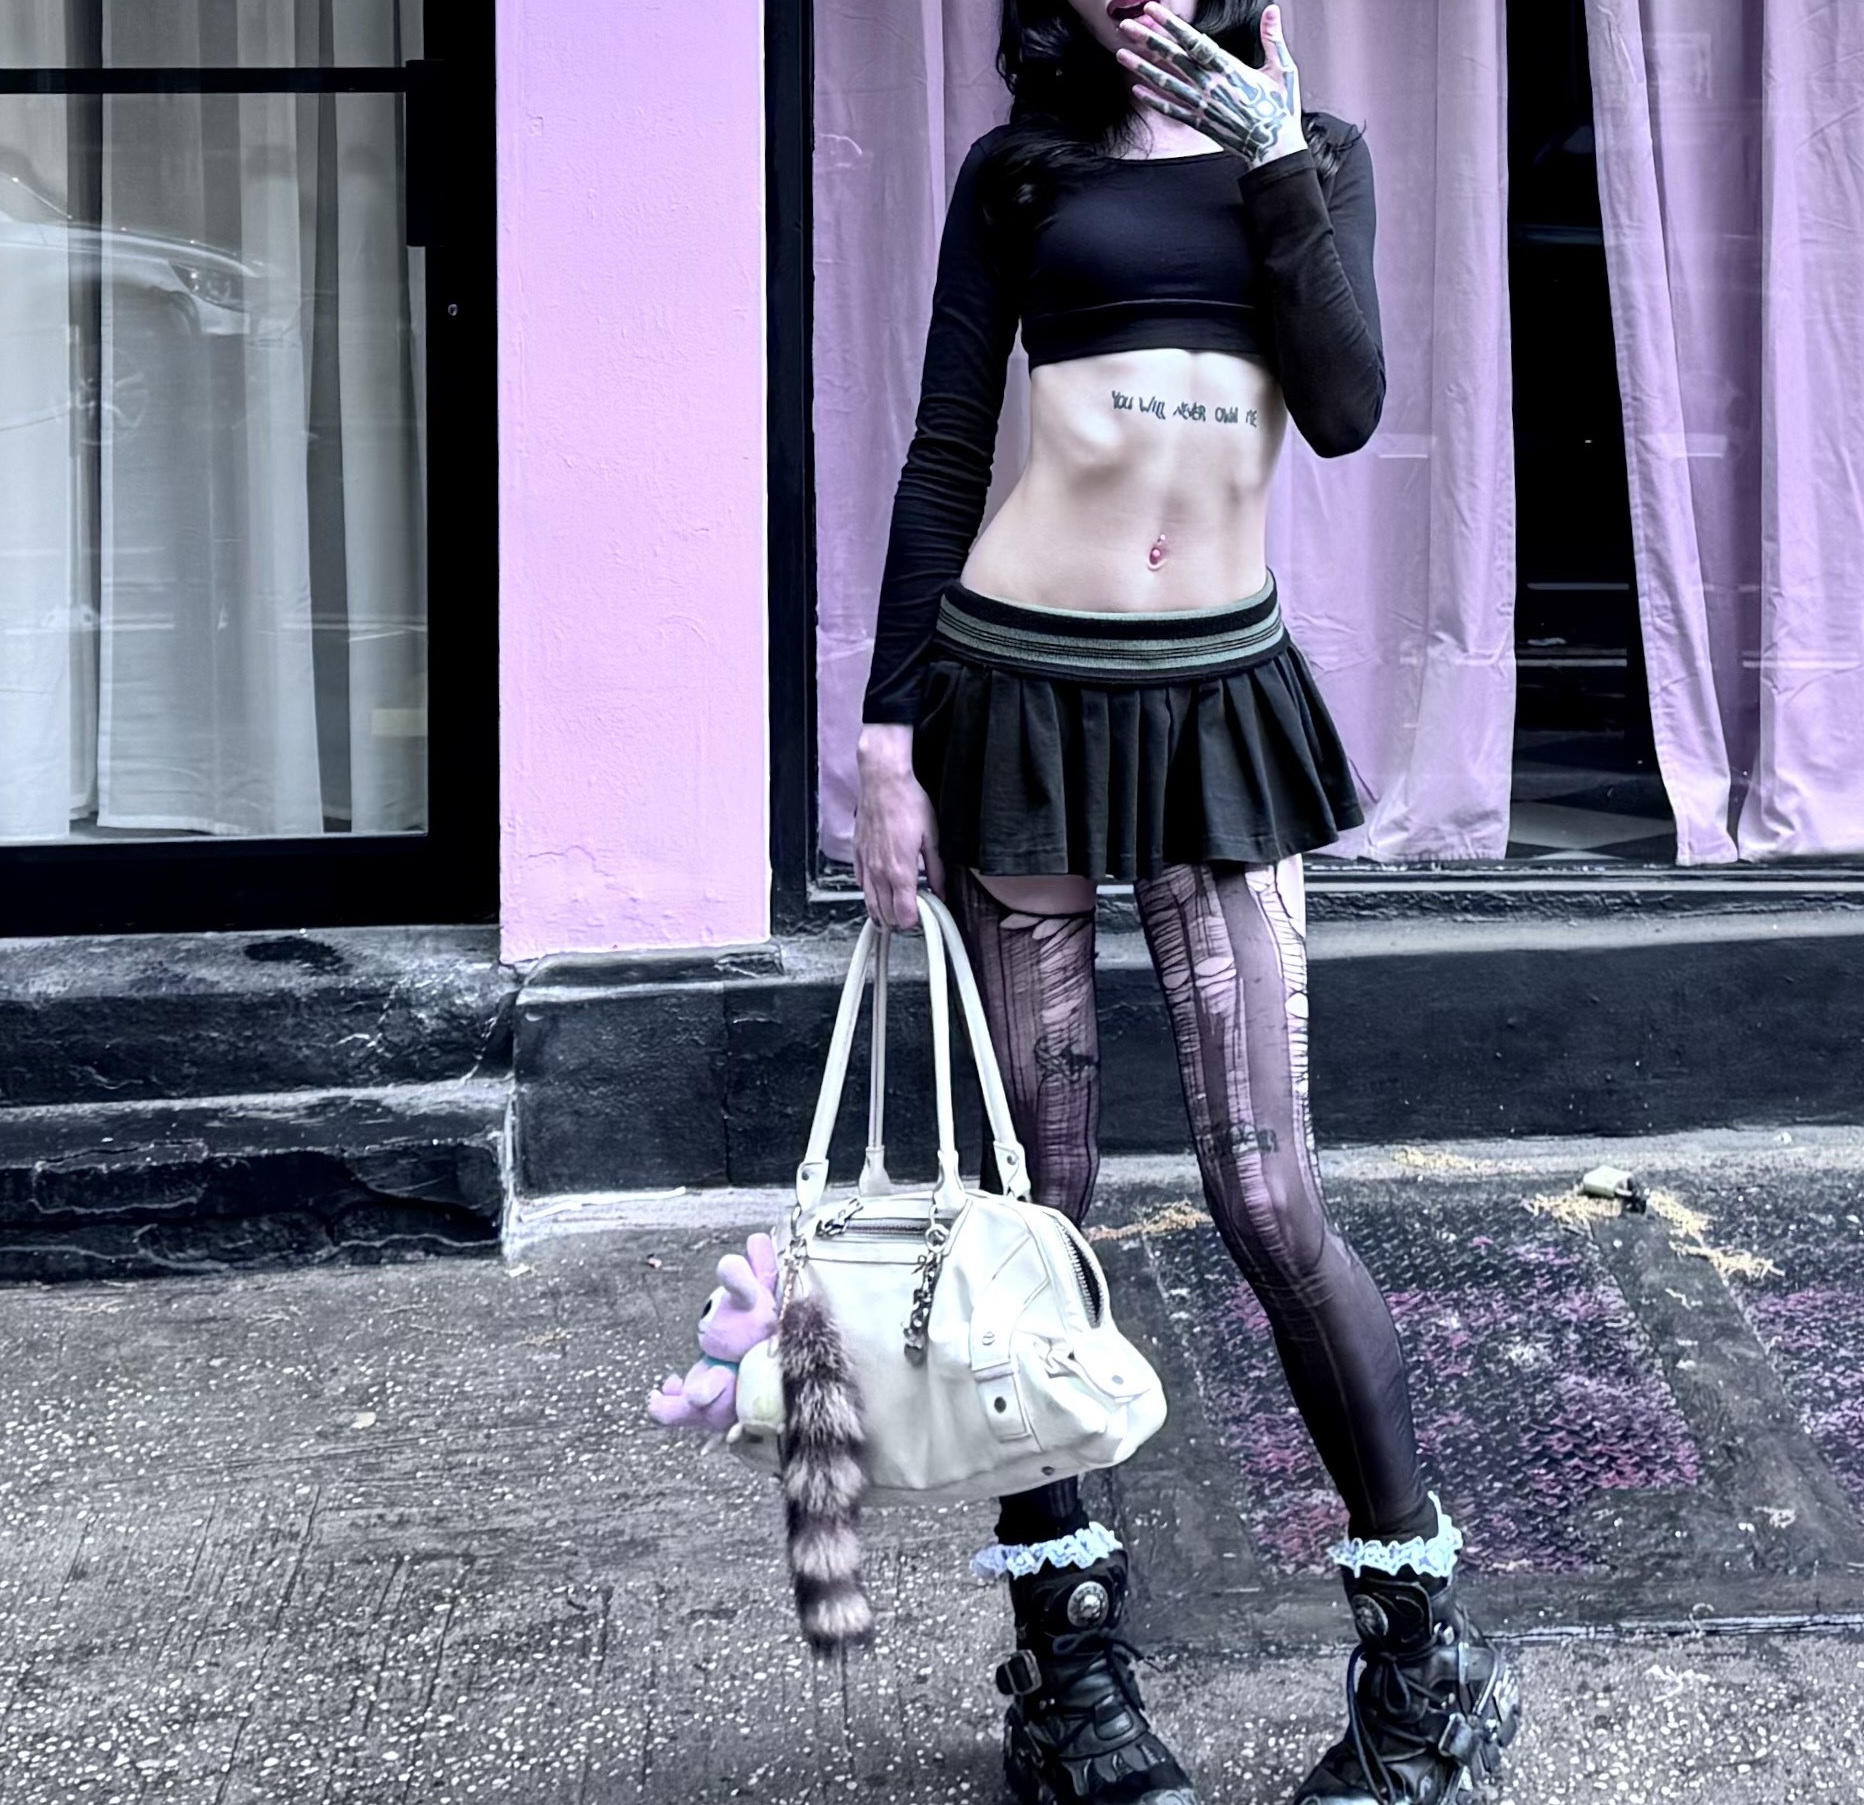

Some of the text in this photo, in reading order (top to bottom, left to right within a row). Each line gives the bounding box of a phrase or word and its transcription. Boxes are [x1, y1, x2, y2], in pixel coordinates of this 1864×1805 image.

[1111, 390, 1133, 410] YOU
[1139, 396, 1166, 420] WILL
[1173, 400, 1206, 423] NEVER
[1215, 406, 1238, 424] OWN
